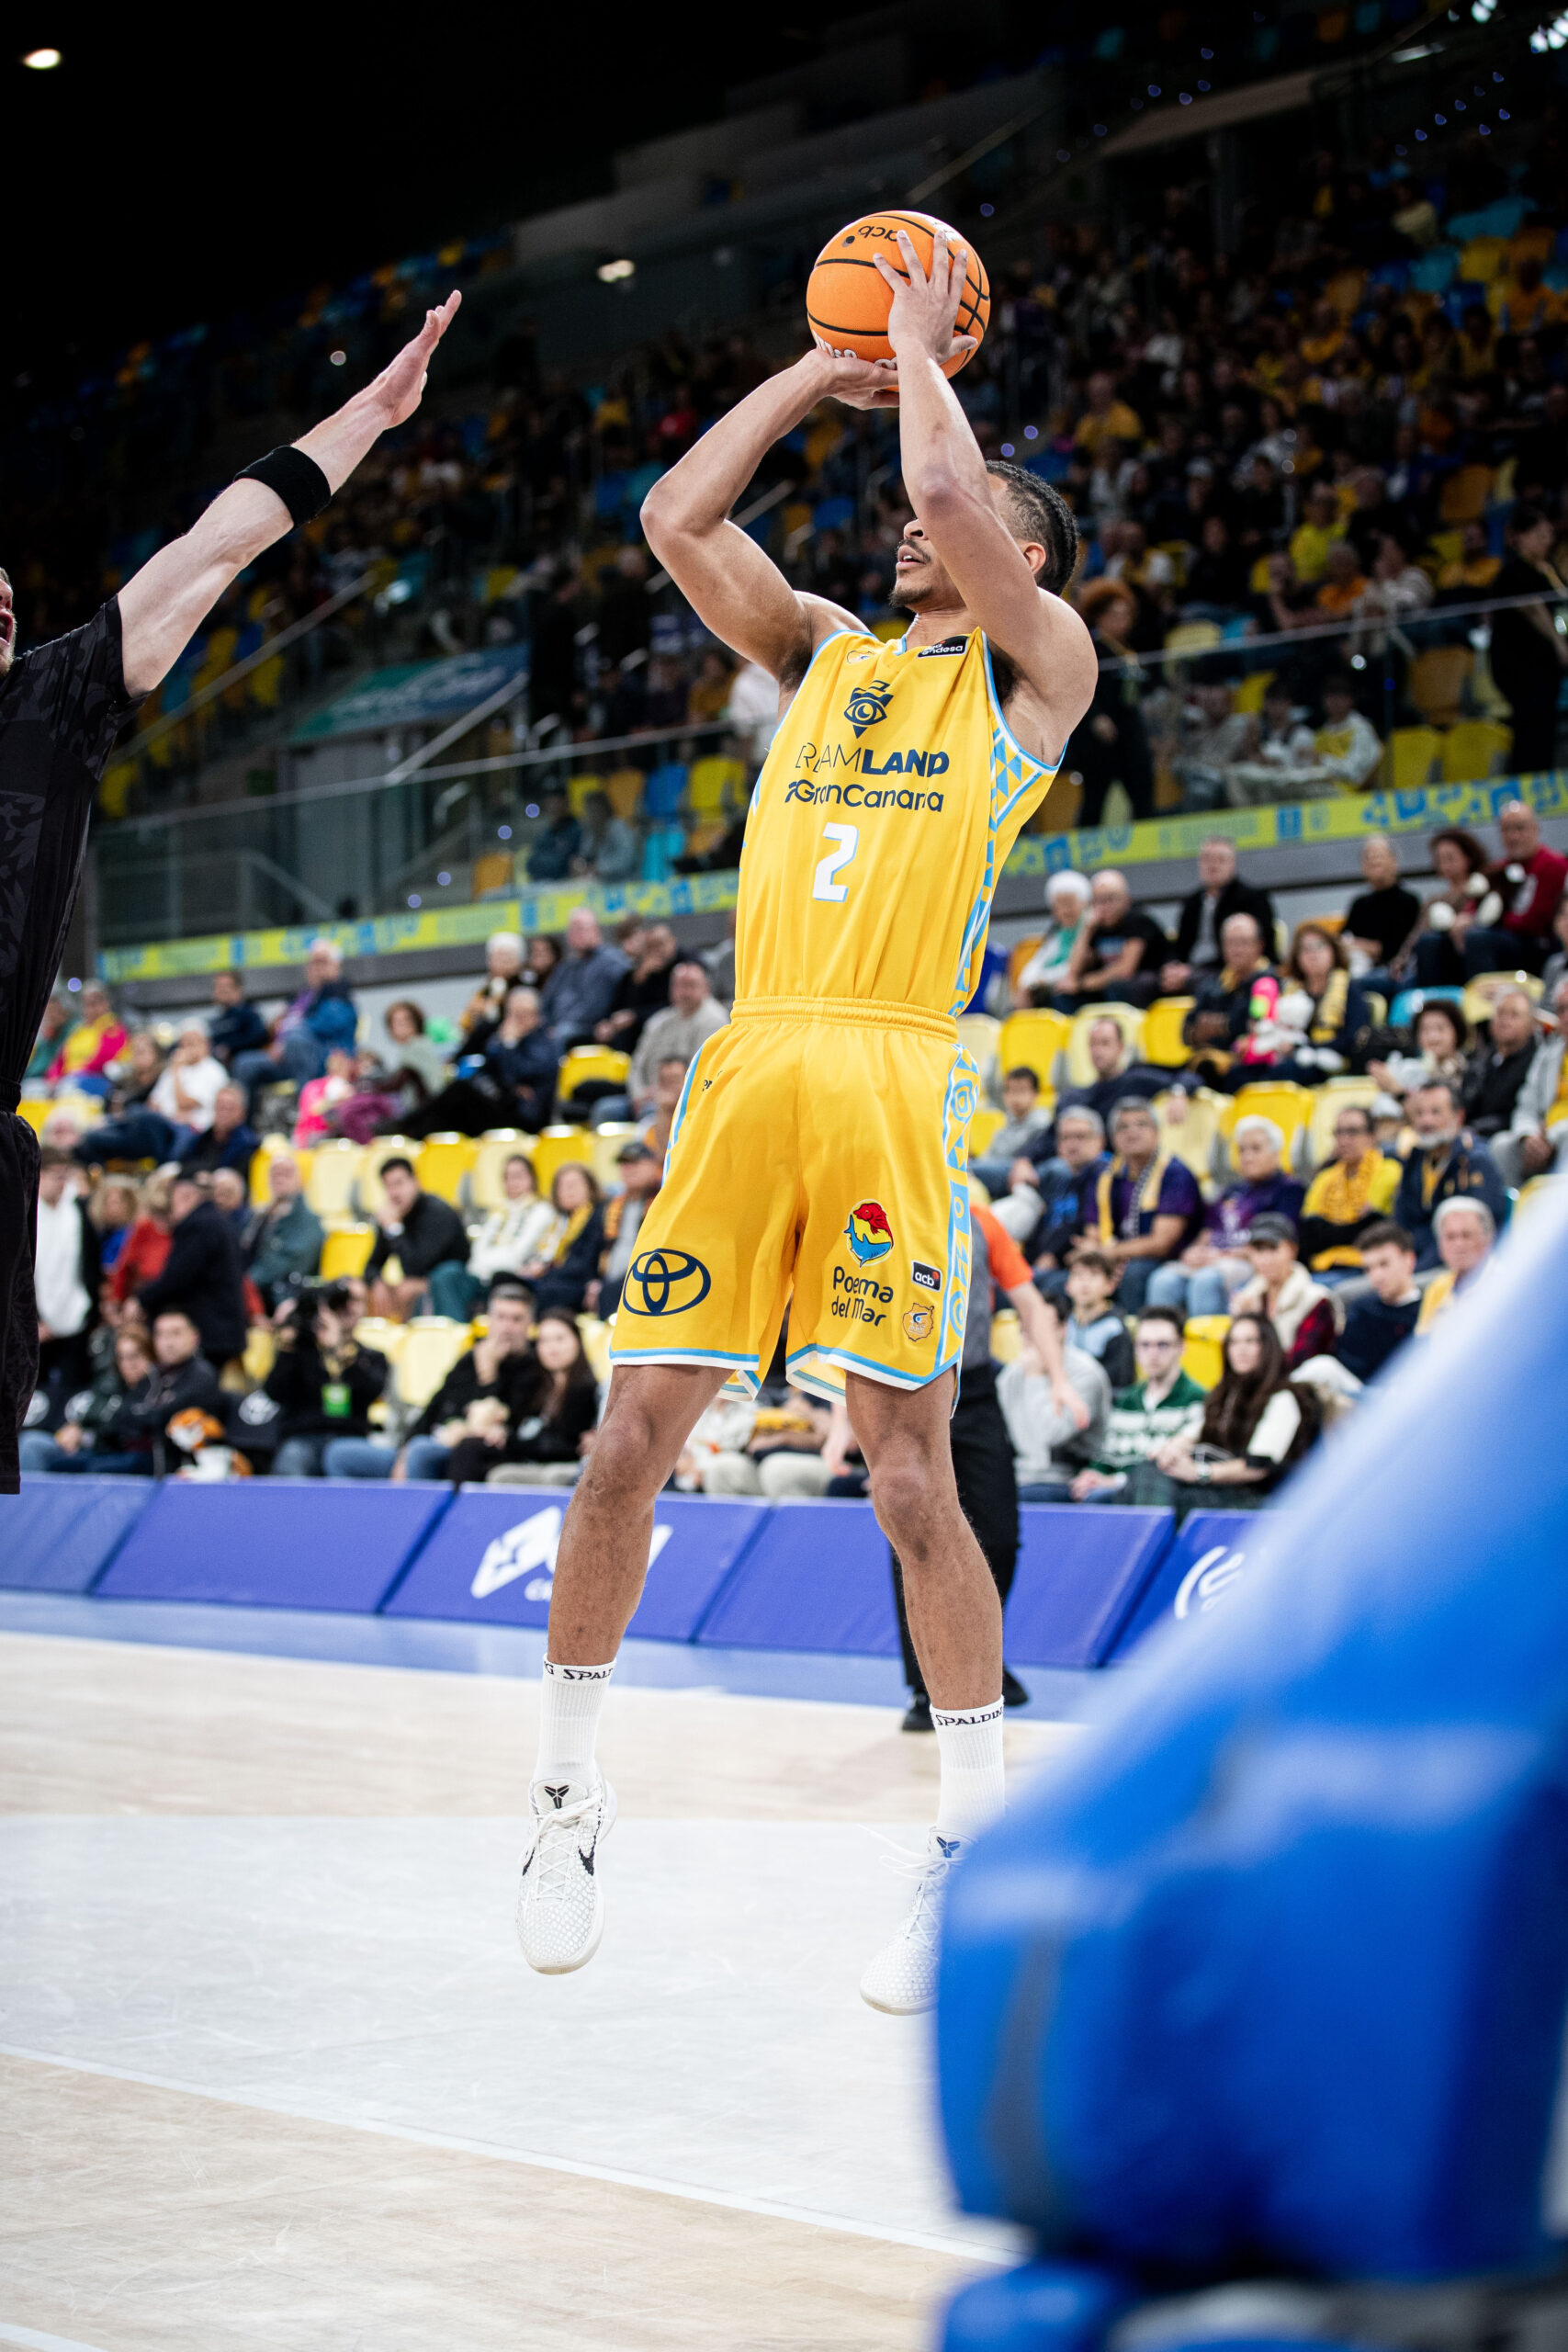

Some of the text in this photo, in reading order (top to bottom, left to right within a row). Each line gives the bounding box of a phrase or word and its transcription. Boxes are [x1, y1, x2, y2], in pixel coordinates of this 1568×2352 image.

[857, 225, 898, 242] acb
[921, 645, 964, 655] endesa
[795, 742, 950, 778] RAMLAND
[812, 821, 860, 903] 2
[833, 1266, 894, 1304] Poema
[915, 1272, 935, 1287] acb
[831, 1295, 887, 1327] del Mar
